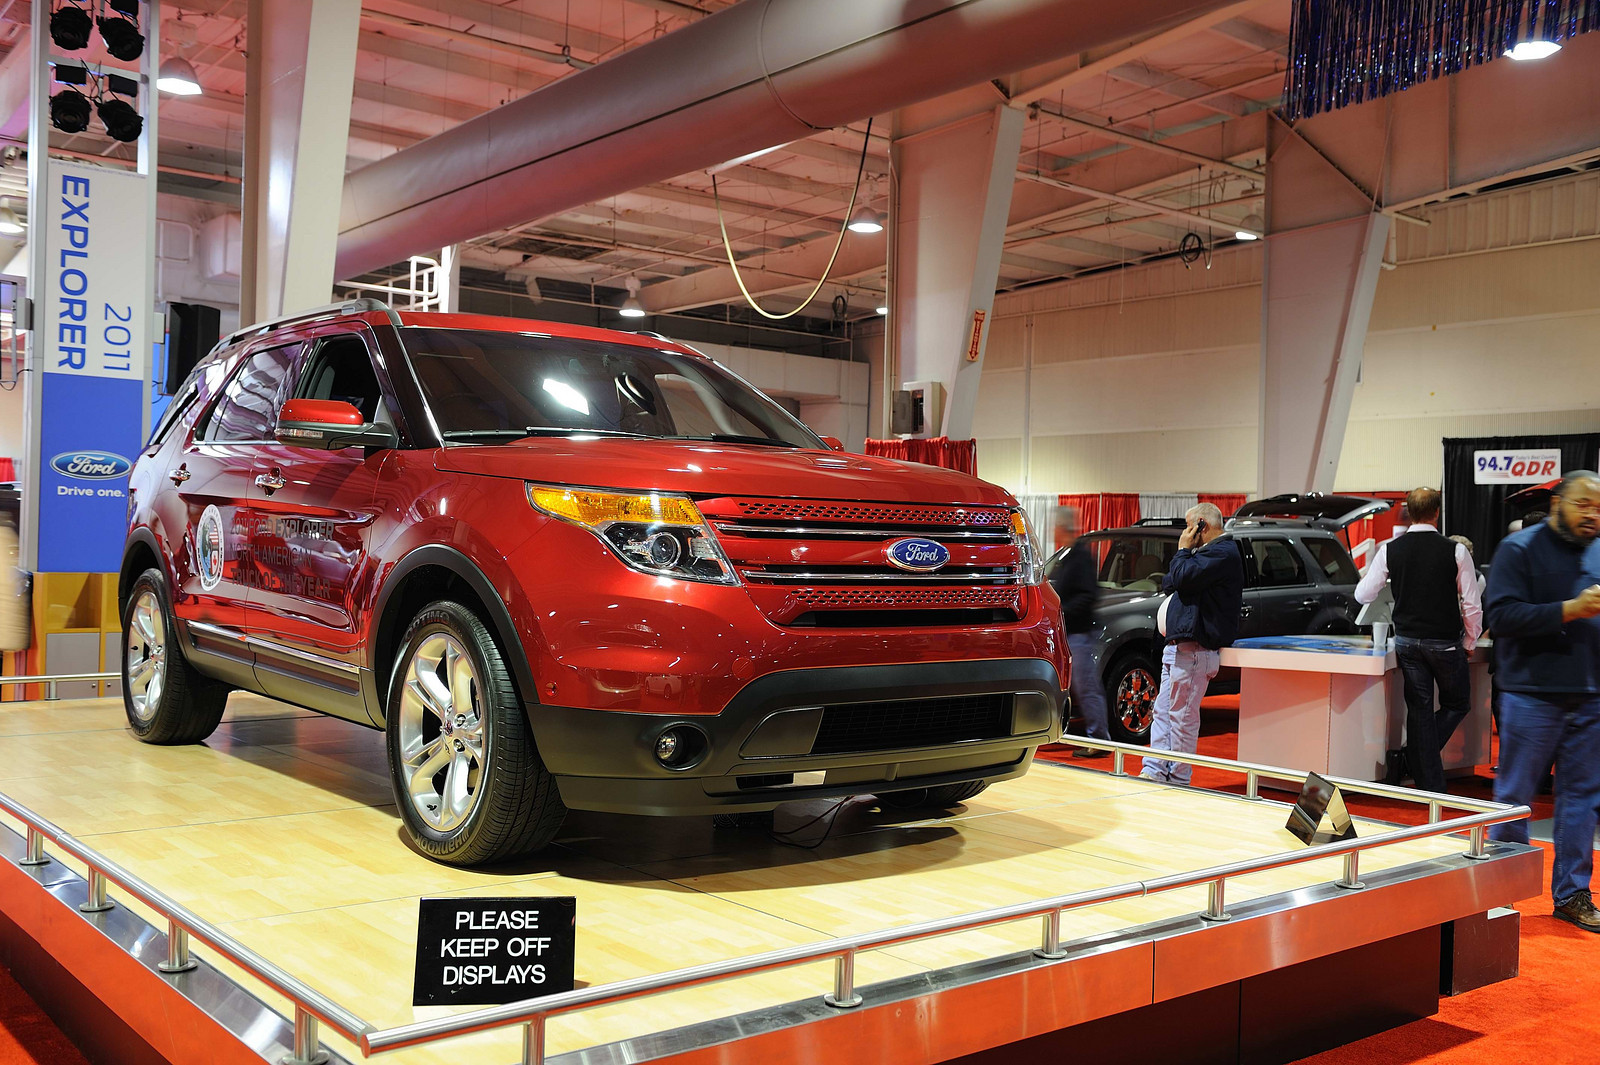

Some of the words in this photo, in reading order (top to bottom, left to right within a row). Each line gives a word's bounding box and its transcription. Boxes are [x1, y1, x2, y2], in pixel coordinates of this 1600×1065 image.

[58, 174, 90, 370] EXPLORER
[103, 302, 132, 372] 2011
[67, 454, 117, 475] Ford
[1477, 456, 1513, 471] 94.7
[1511, 460, 1556, 476] QDR
[57, 485, 94, 496] Drive
[97, 488, 126, 498] one.
[249, 518, 273, 537] FORD
[275, 518, 334, 541] EXPLORER
[230, 542, 260, 562] NORTH
[262, 545, 312, 569] AMERICAN
[905, 543, 939, 561] Ford
[231, 567, 262, 588] TRUCK
[263, 571, 276, 590] OF
[278, 572, 298, 594] THE
[301, 575, 331, 599] YEAR
[455, 910, 539, 930] PLEASE
[440, 938, 500, 958] KEEP
[506, 937, 551, 957] OFF
[442, 964, 546, 986] DISPLAYS
